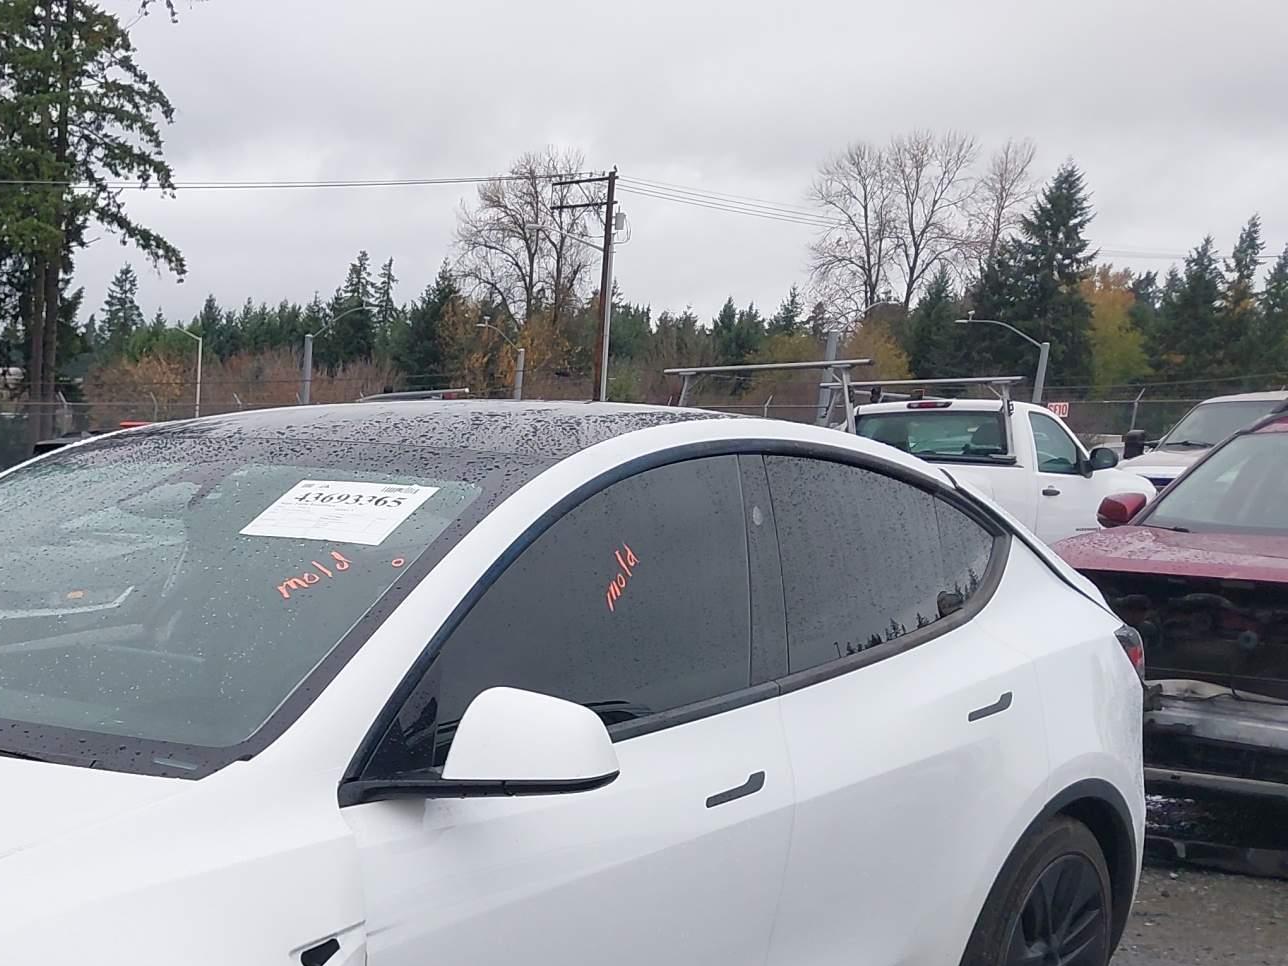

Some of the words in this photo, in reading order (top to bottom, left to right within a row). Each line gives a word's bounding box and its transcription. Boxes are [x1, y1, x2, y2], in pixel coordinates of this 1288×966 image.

[295, 492, 408, 508] 43693365
[277, 551, 352, 600] mold
[607, 541, 640, 613] mold
